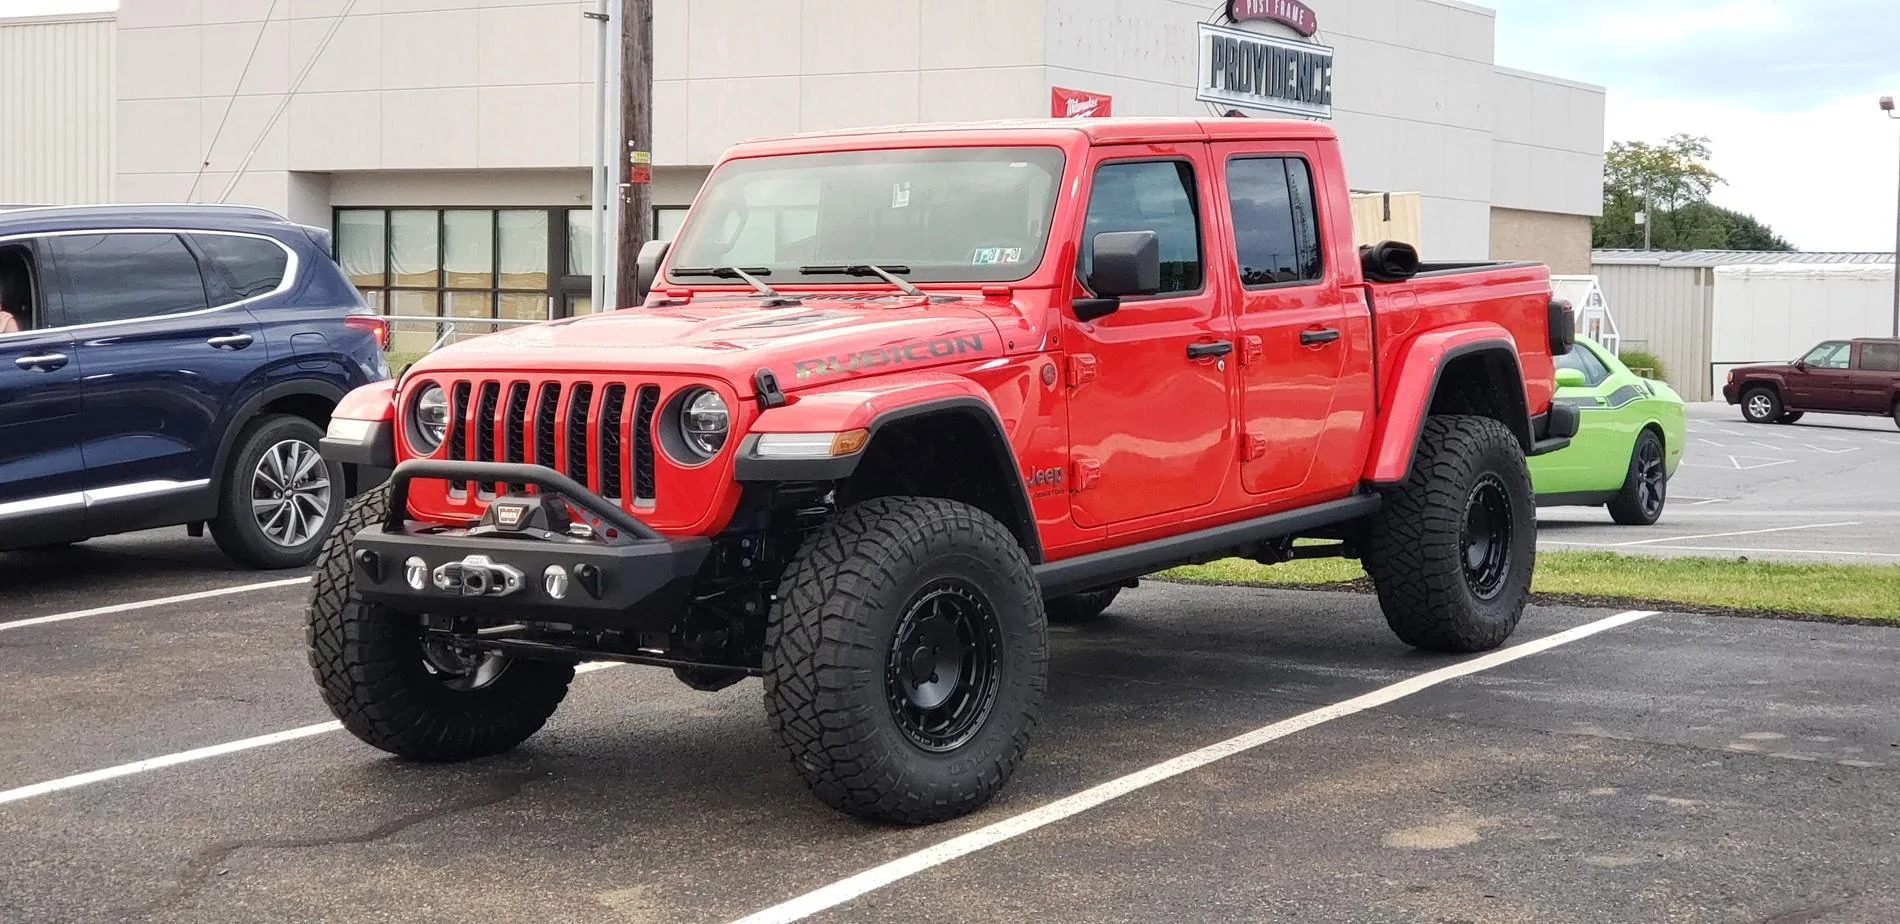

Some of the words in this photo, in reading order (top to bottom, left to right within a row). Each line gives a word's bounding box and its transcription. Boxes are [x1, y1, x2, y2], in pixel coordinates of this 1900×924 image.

[1274, 0, 1305, 25] FRAME
[1210, 34, 1332, 105] PROVIDENCE
[793, 334, 984, 381] RUBICON
[1026, 465, 1064, 488] Jeep
